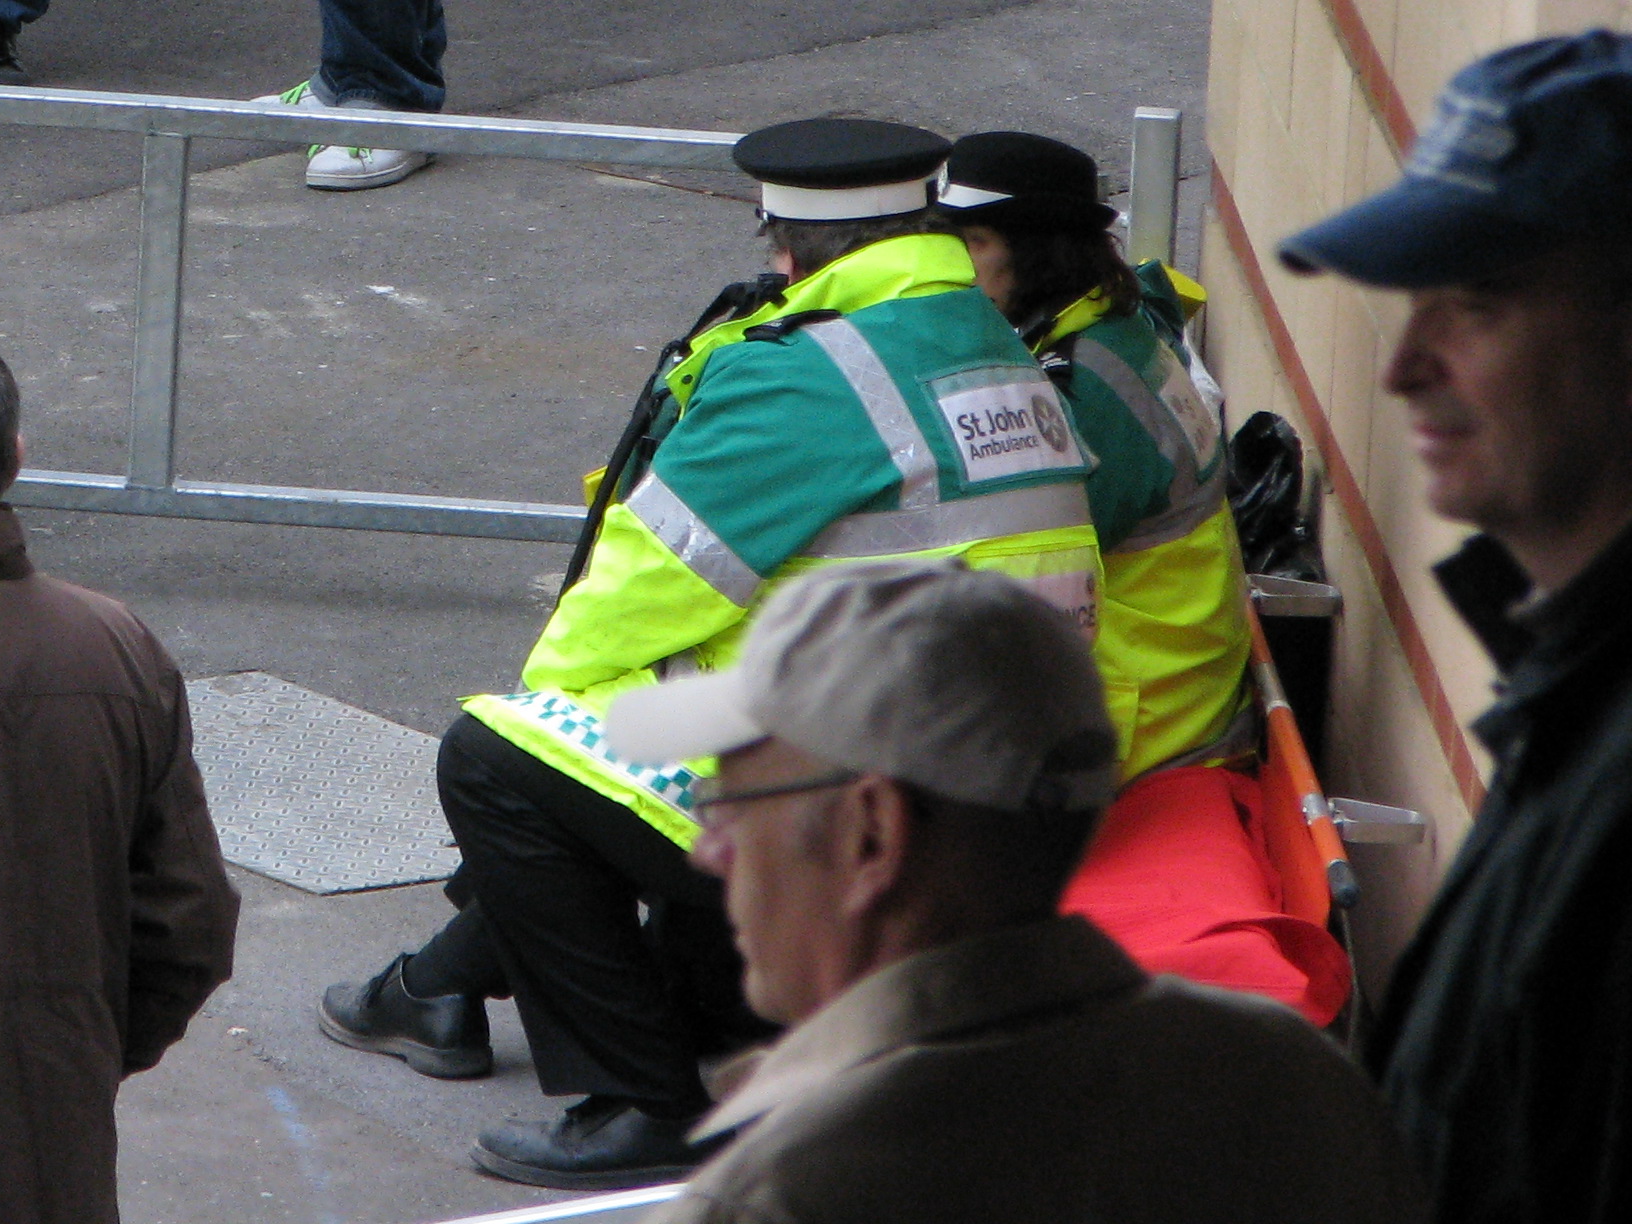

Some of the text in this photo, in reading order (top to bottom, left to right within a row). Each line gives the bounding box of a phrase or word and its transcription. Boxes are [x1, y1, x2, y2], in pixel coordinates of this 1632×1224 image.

[956, 405, 1033, 441] St John
[969, 434, 1040, 461] Ambulance
